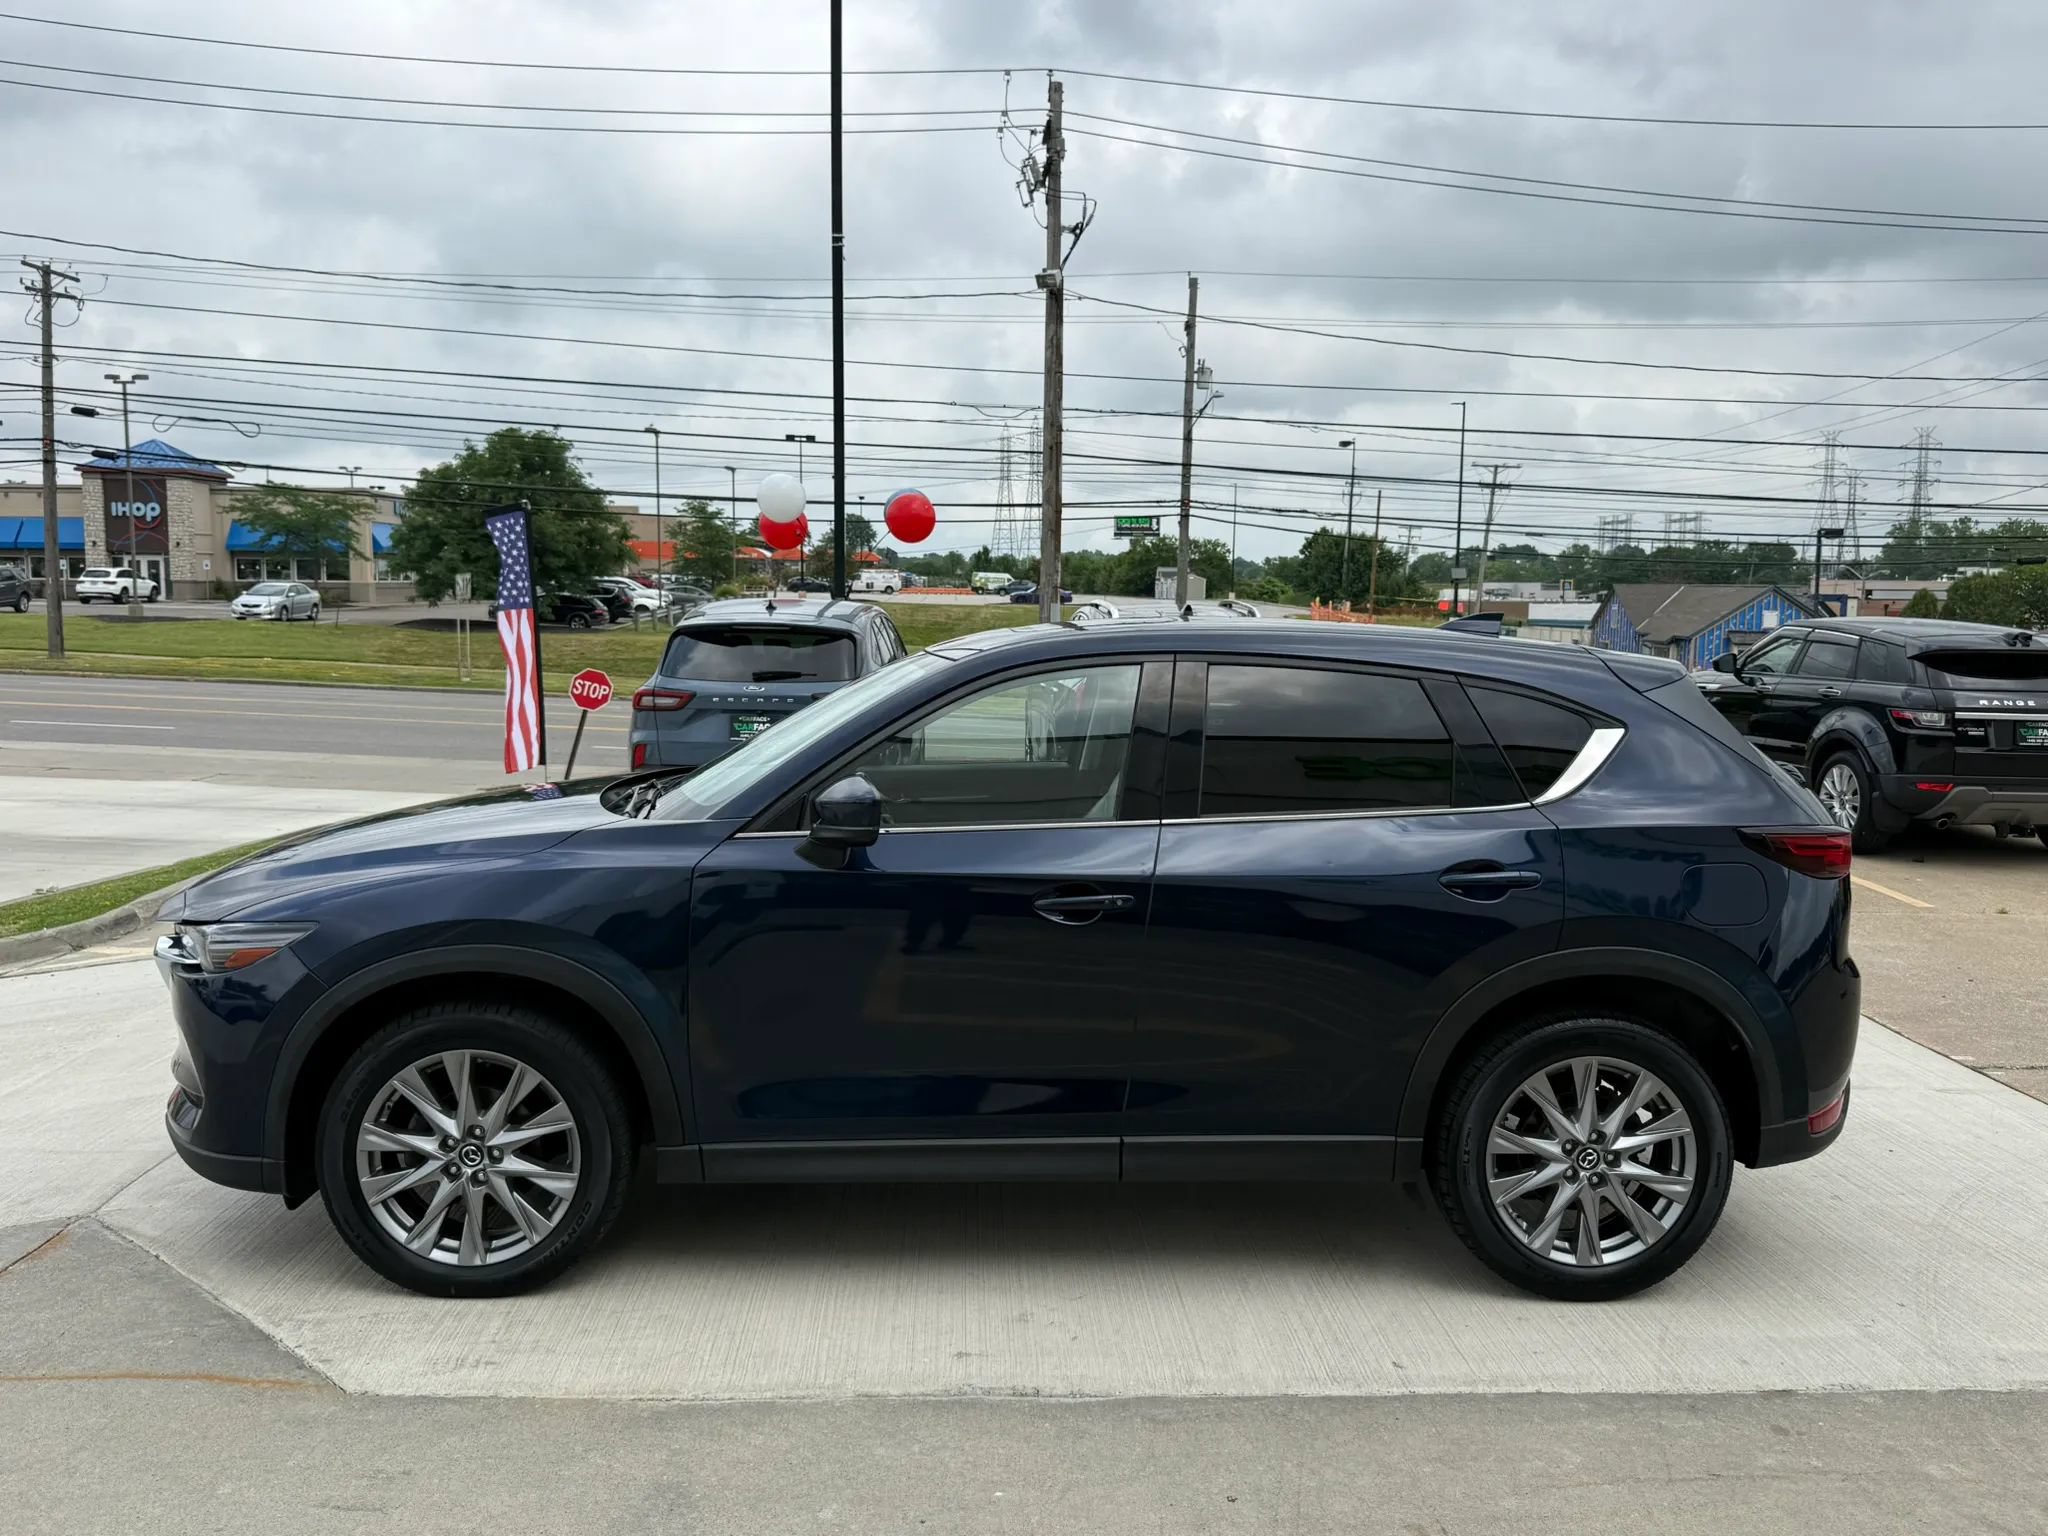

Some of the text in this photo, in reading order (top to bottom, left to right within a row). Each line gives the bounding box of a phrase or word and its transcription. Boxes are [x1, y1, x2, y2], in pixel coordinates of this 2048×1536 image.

[111, 502, 161, 522] IHOP
[573, 679, 610, 700] STOP
[734, 723, 771, 731] CARFAC
[2020, 728, 2048, 736] CARFA
